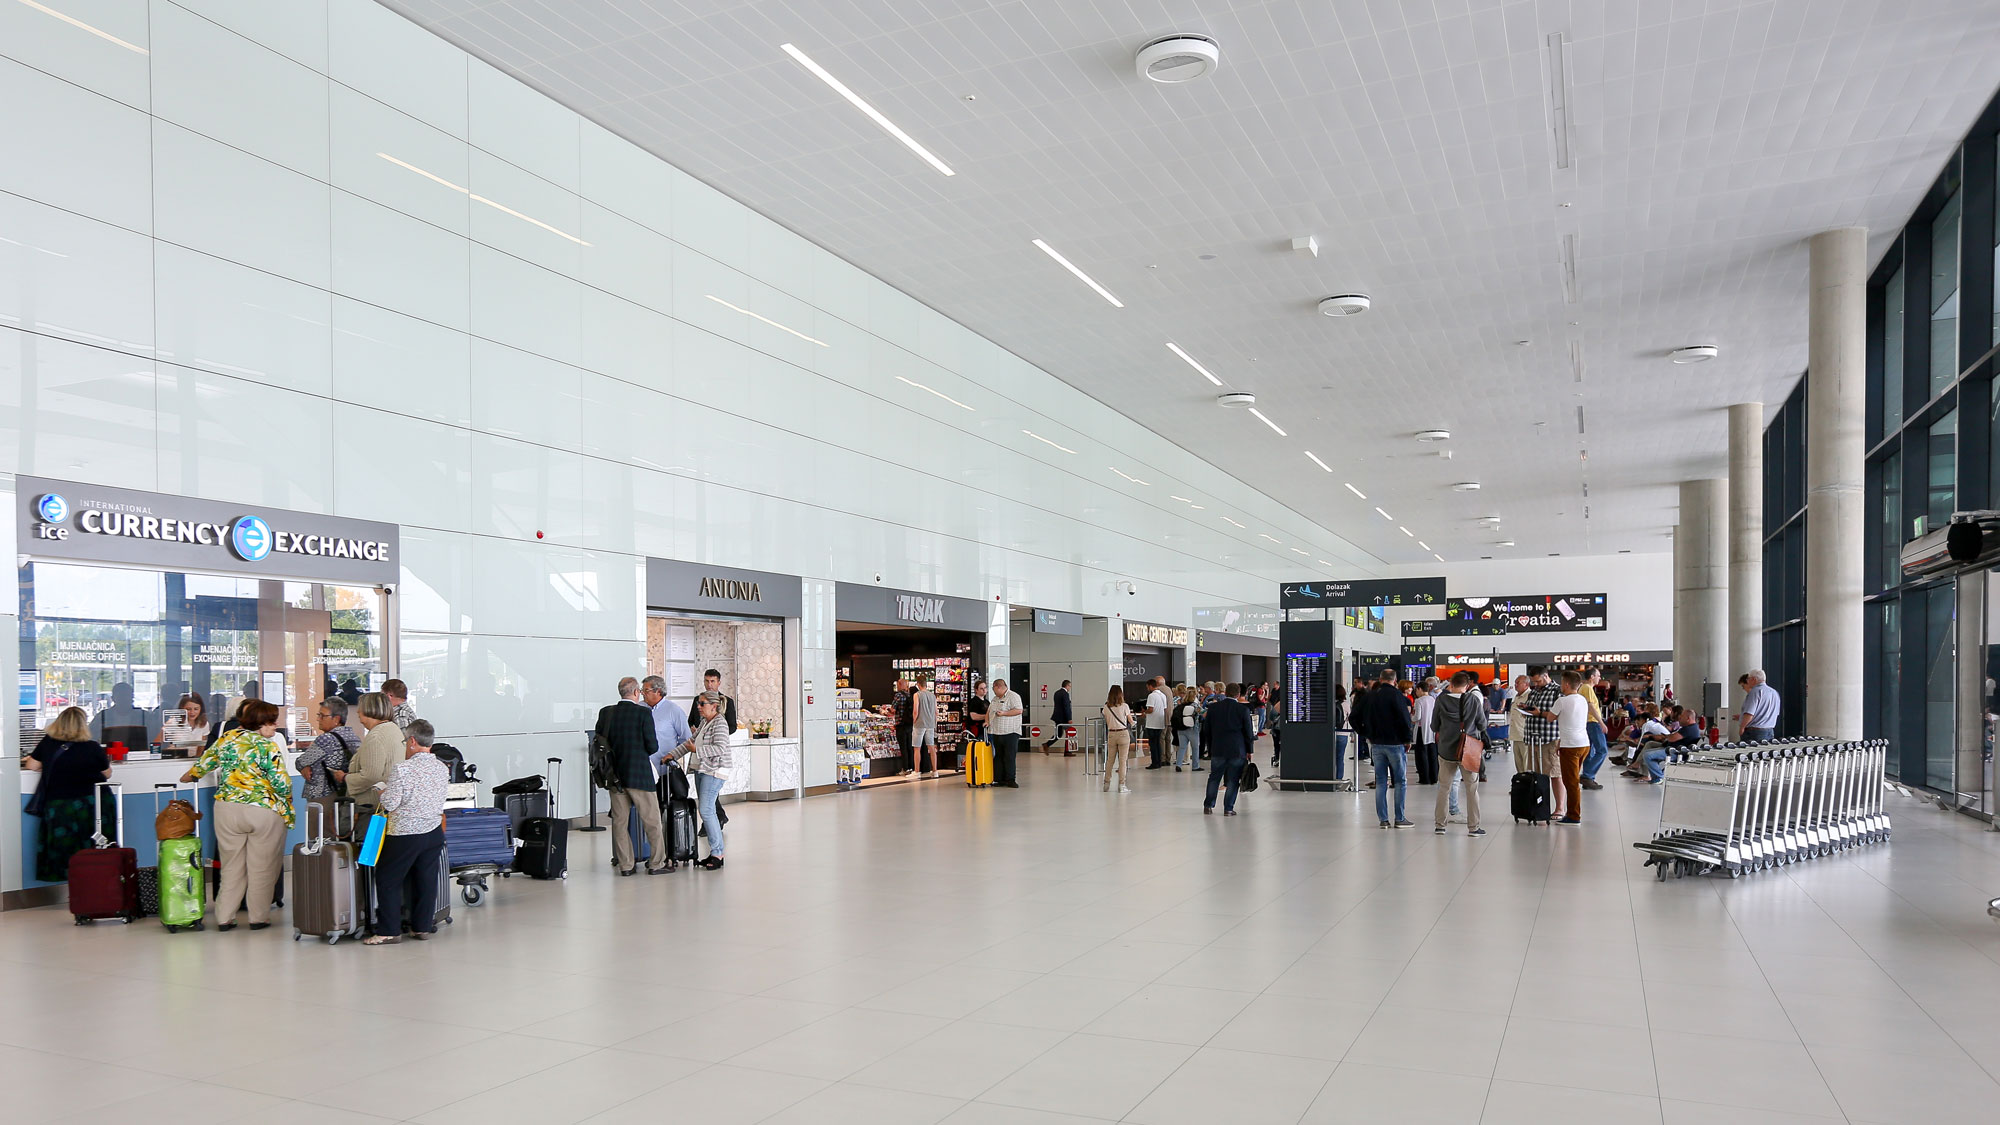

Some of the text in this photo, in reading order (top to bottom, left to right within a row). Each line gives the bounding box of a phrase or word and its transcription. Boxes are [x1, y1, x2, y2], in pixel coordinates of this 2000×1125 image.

[80, 499, 153, 515] INTERNATIONAL
[40, 522, 69, 540] ice
[81, 509, 230, 546] CURRENCY
[275, 531, 389, 561] EXCHANGE
[699, 577, 762, 602] ANTONIA
[1325, 590, 1346, 598] Arrival
[897, 594, 945, 623] TISAK
[1493, 602, 1544, 612] Welcome to
[1126, 622, 1187, 645] VISITOR CENTER ZAGREB
[59, 640, 116, 651] MJENJAČNICA
[200, 644, 247, 654] MJENJAČNICA
[51, 651, 126, 661] EXCHANGE OFFICE
[194, 654, 256, 664] EXCHANGE OFFICE
[1554, 652, 1630, 663] CAFFÈ NERO
[1123, 663, 1146, 678] greb
